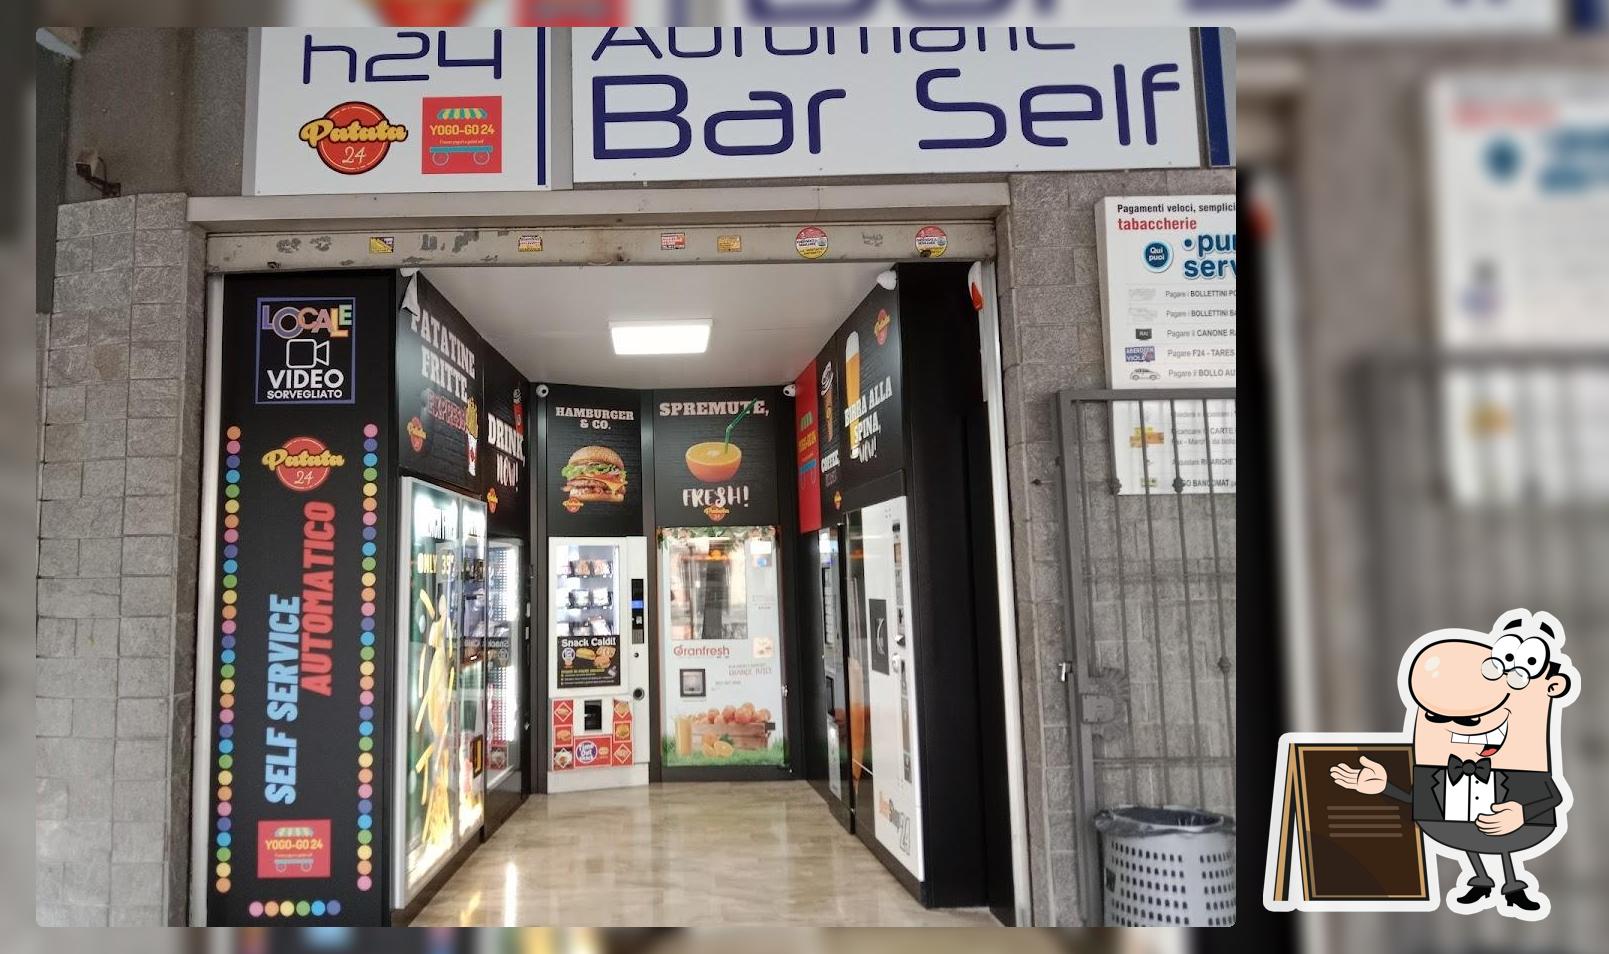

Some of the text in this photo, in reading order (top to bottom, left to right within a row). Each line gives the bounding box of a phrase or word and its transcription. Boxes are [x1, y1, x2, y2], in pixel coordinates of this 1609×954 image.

[303, 29, 502, 84] h24
[592, 63, 1180, 160] Bar Self
[299, 118, 408, 148] Patata
[429, 124, 495, 136] YOGO-GO 24
[342, 147, 366, 164] 24
[1117, 204, 1164, 214] Pagamenti
[1167, 203, 1196, 213] veloci,
[1118, 218, 1197, 230] tabaccherie
[262, 304, 352, 338] LOCALE
[267, 368, 344, 389] VIDEO
[421, 344, 467, 403] FRITTE
[267, 389, 342, 399] SORVEGLIATO
[869, 376, 893, 410] ALLA
[555, 406, 635, 421] HAMBURGER
[659, 400, 769, 417] SPREMUTE,
[580, 419, 612, 430] & CO.
[262, 449, 345, 471] Patata
[294, 470, 315, 485] 24
[683, 485, 749, 507] FRESH!
[417, 552, 438, 574] ONLY
[301, 501, 336, 697] AUTOMATICO
[561, 638, 589, 648] Snack
[264, 593, 300, 805] SELF SERVICE
[265, 838, 324, 851] YOGO-GO 24
